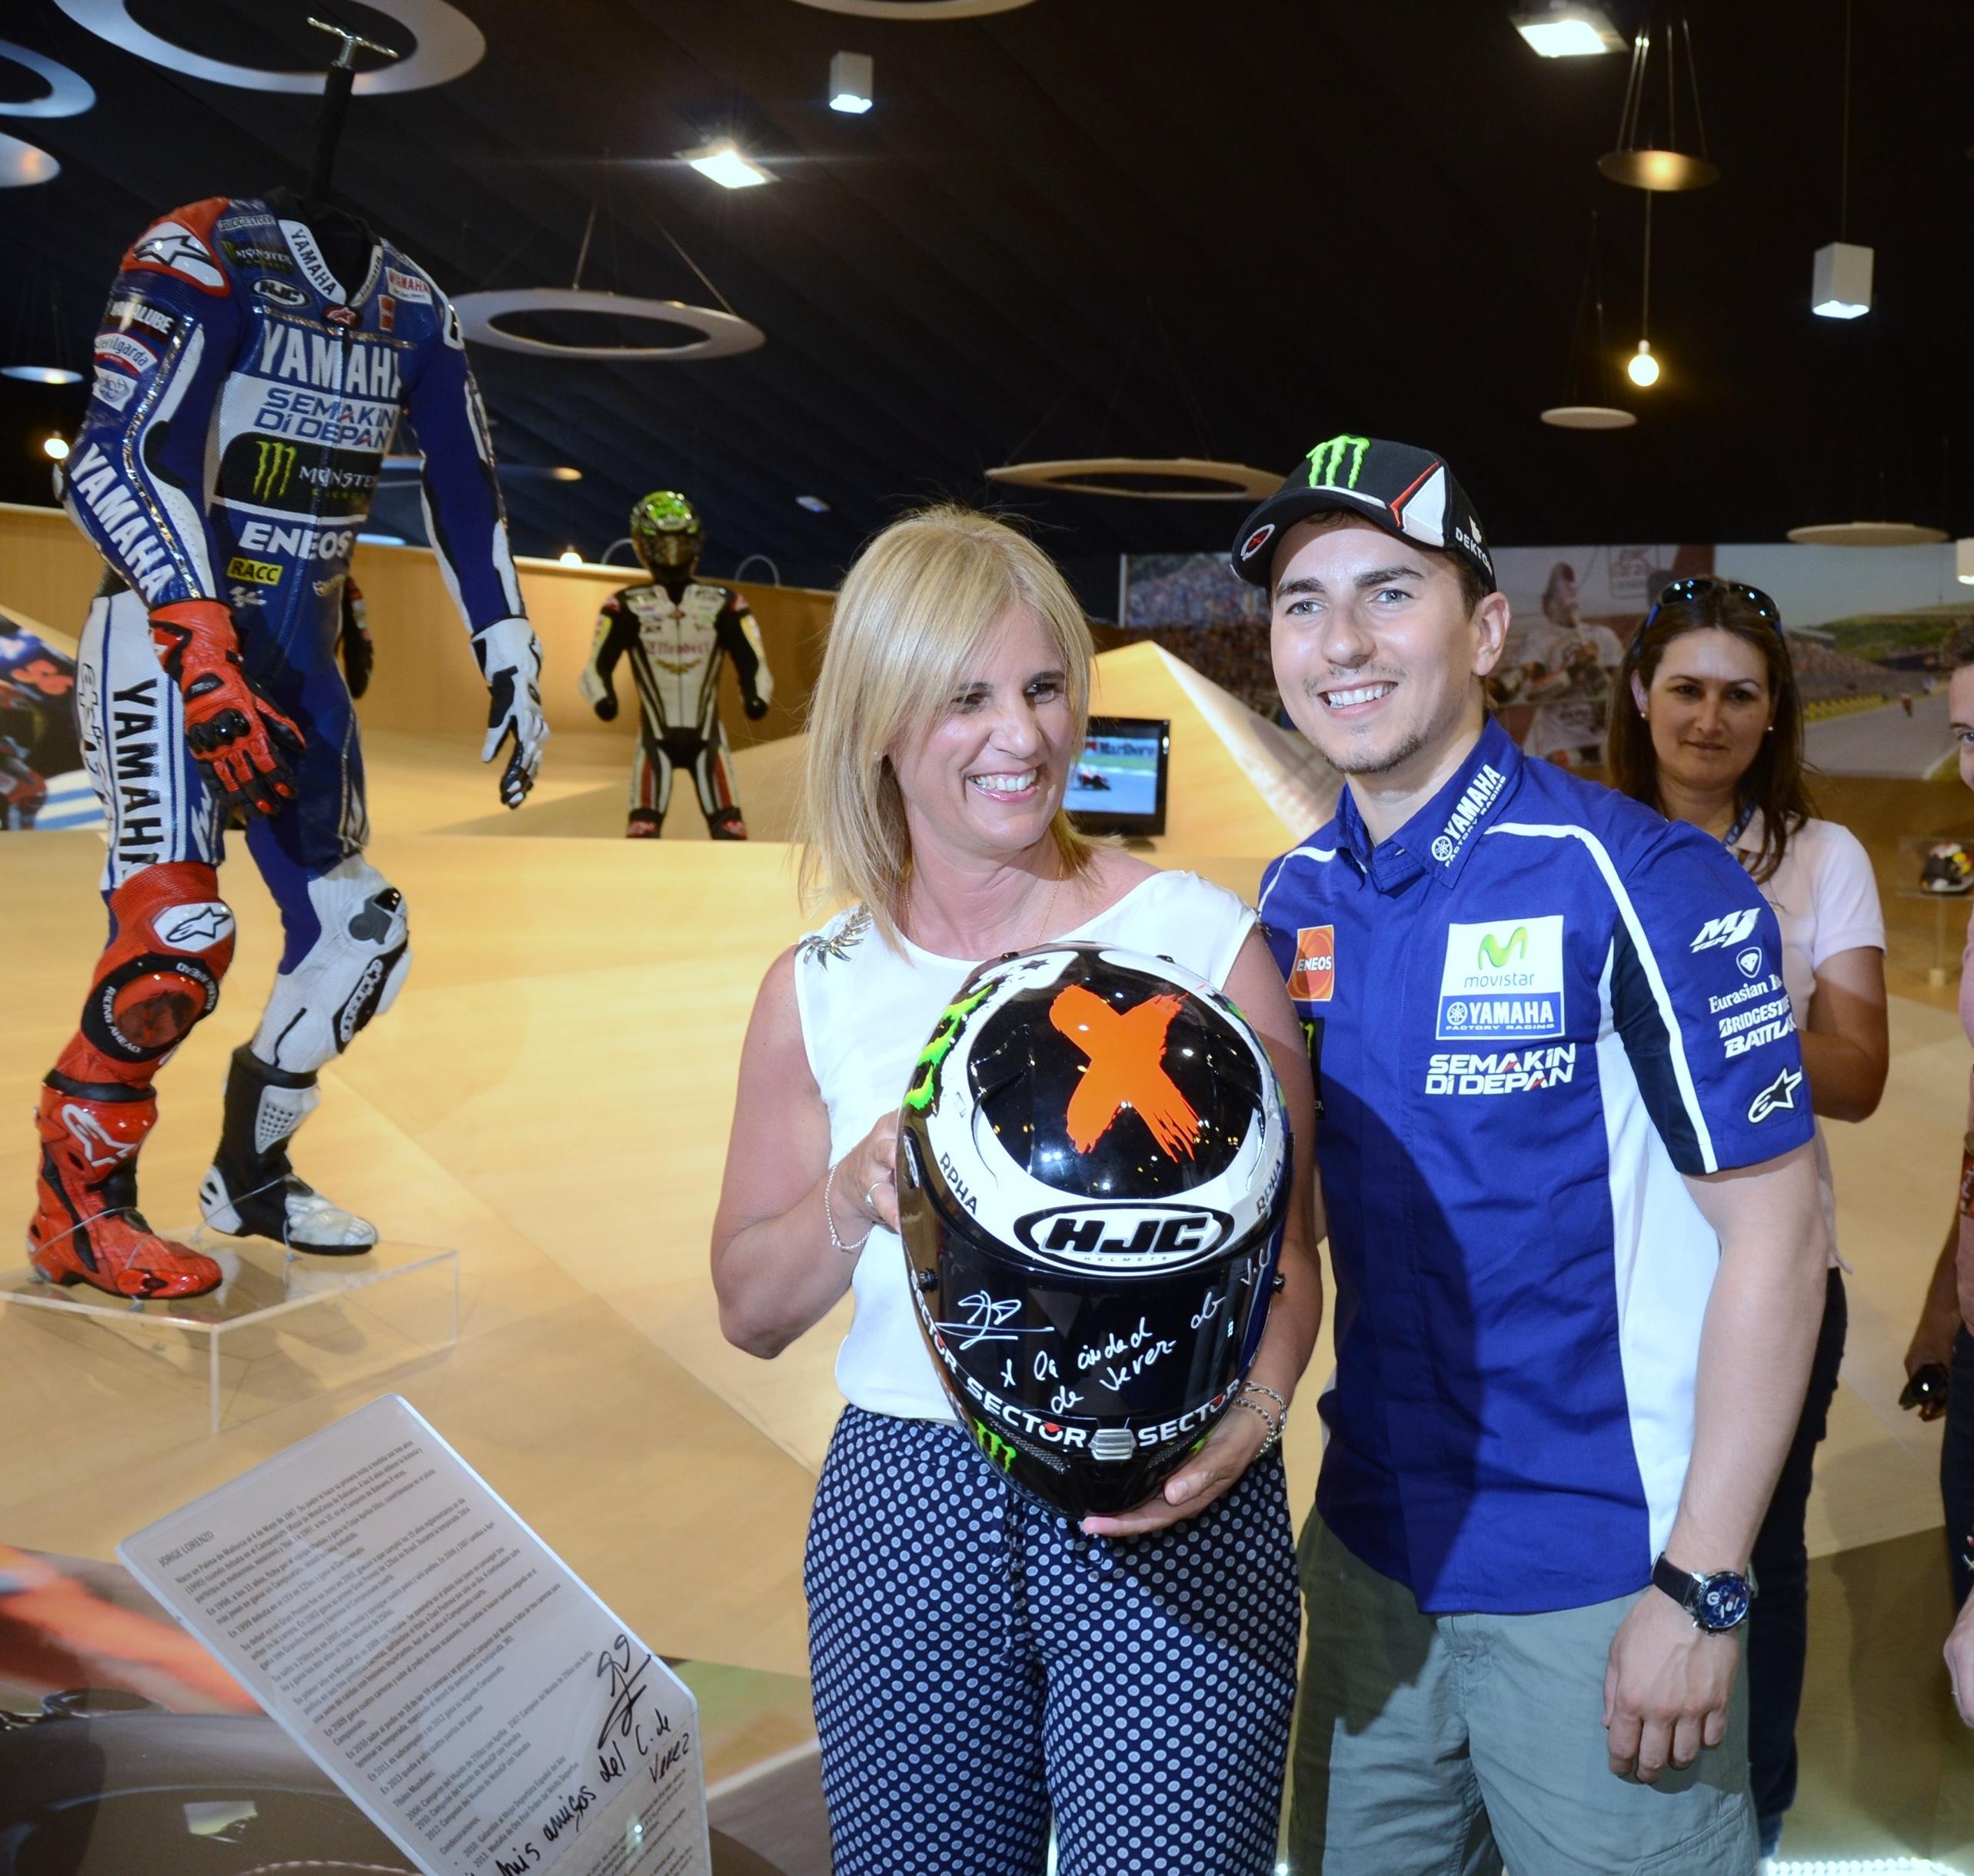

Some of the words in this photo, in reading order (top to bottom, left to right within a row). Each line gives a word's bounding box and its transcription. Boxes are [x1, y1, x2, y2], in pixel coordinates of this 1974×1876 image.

[291, 228, 338, 296] YAMAHA
[263, 387, 397, 428] SEMAKIN
[298, 465, 374, 488] MONSTE
[70, 442, 175, 606] YAMAHA
[238, 521, 353, 560] ENEOS
[230, 561, 280, 582] RACC
[1443, 764, 1501, 840] YAMAHA
[1444, 818, 1477, 868] FACTORY
[1480, 775, 1506, 815] RACING
[1297, 955, 1333, 972] ENEOS
[1463, 972, 1536, 989] movistar
[1470, 1001, 1554, 1025] YAMAHA
[1708, 981, 1769, 1014] Eurasian
[108, 1025, 142, 1054] AHEAD
[1505, 1022, 1556, 1031] RACING
[1427, 1042, 1576, 1075] SEMAKIN
[1458, 1064, 1574, 1096] DEPAN
[939, 1151, 978, 1215] RPHA
[1255, 1158, 1283, 1218] RPHA
[1042, 1213, 1211, 1255] HJC
[910, 1268, 957, 1374] SECTOR
[966, 1376, 1087, 1449] SECTOR
[1137, 1379, 1241, 1448] SECTOR
[156, 1548, 184, 1567] JORGE
[179, 1530, 215, 1554] LORENZO
[543, 1784, 597, 1842] amigos
[599, 1740, 627, 1783] del
